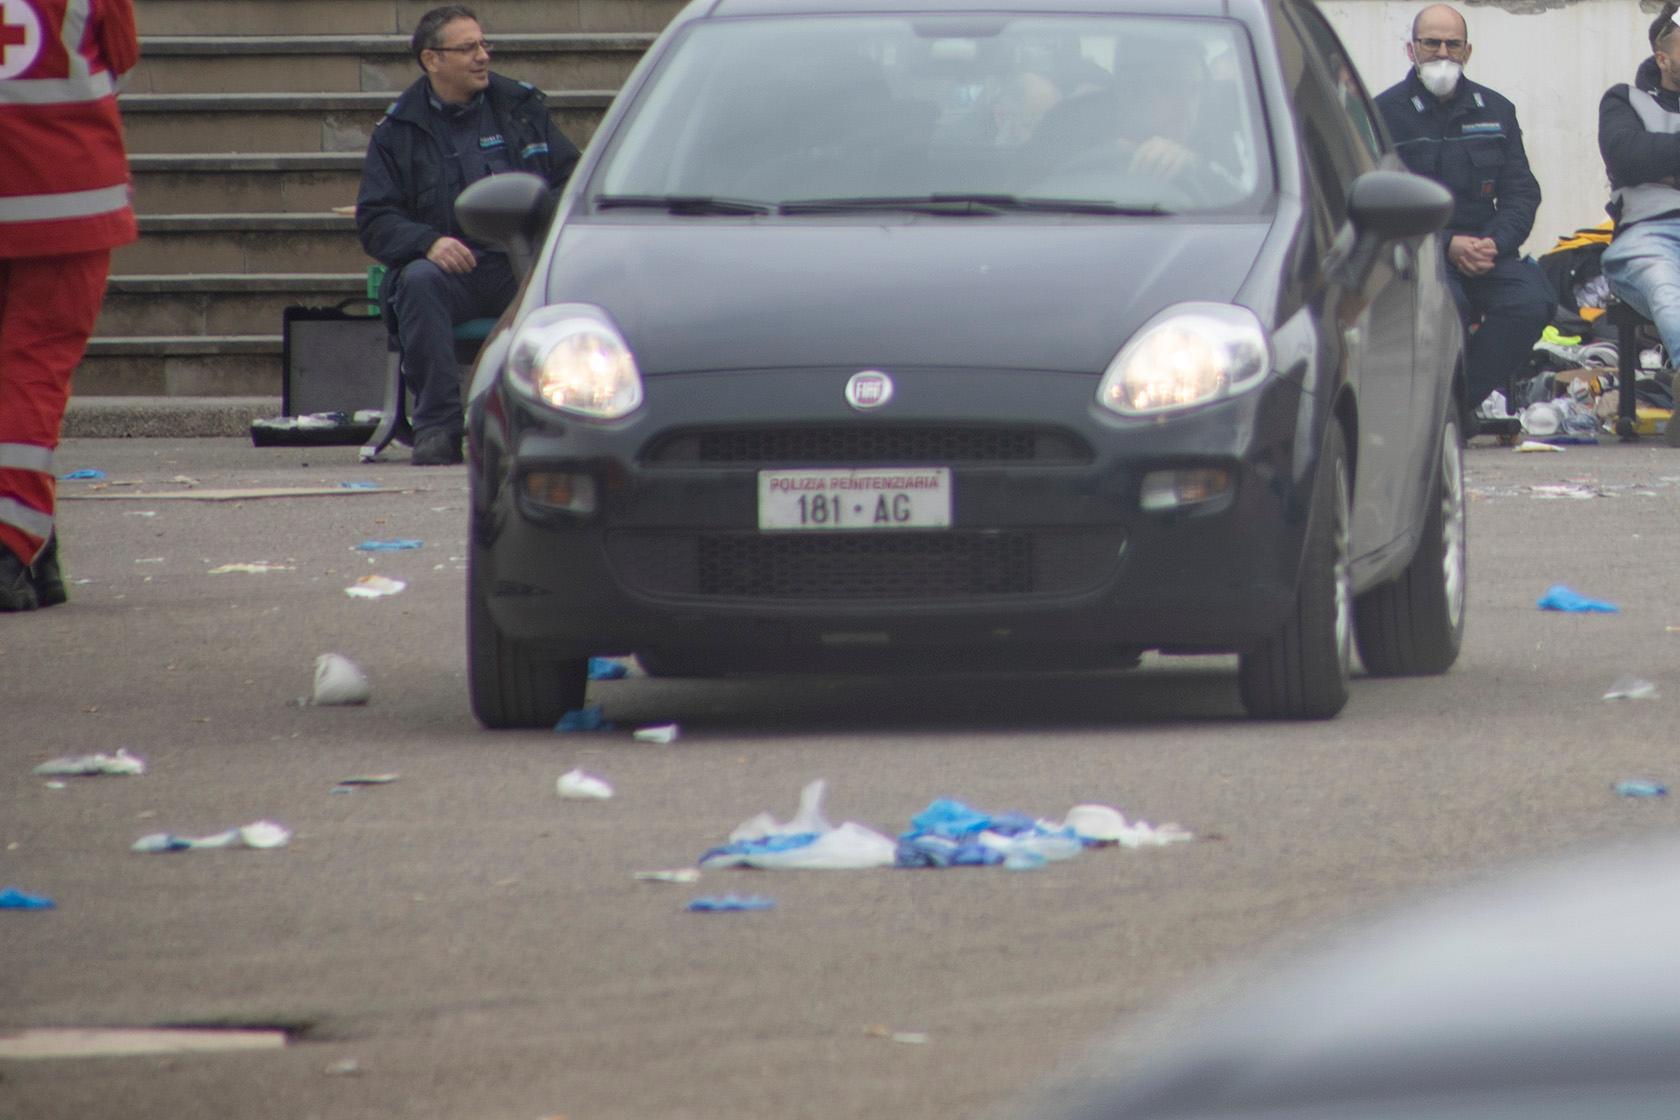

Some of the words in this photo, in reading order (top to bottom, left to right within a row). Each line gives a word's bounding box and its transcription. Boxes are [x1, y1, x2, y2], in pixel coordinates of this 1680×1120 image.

[769, 476, 826, 493] POLIZIA
[829, 474, 940, 492] PENITENZIARIA
[797, 493, 840, 524] 181
[873, 492, 910, 523] AG
